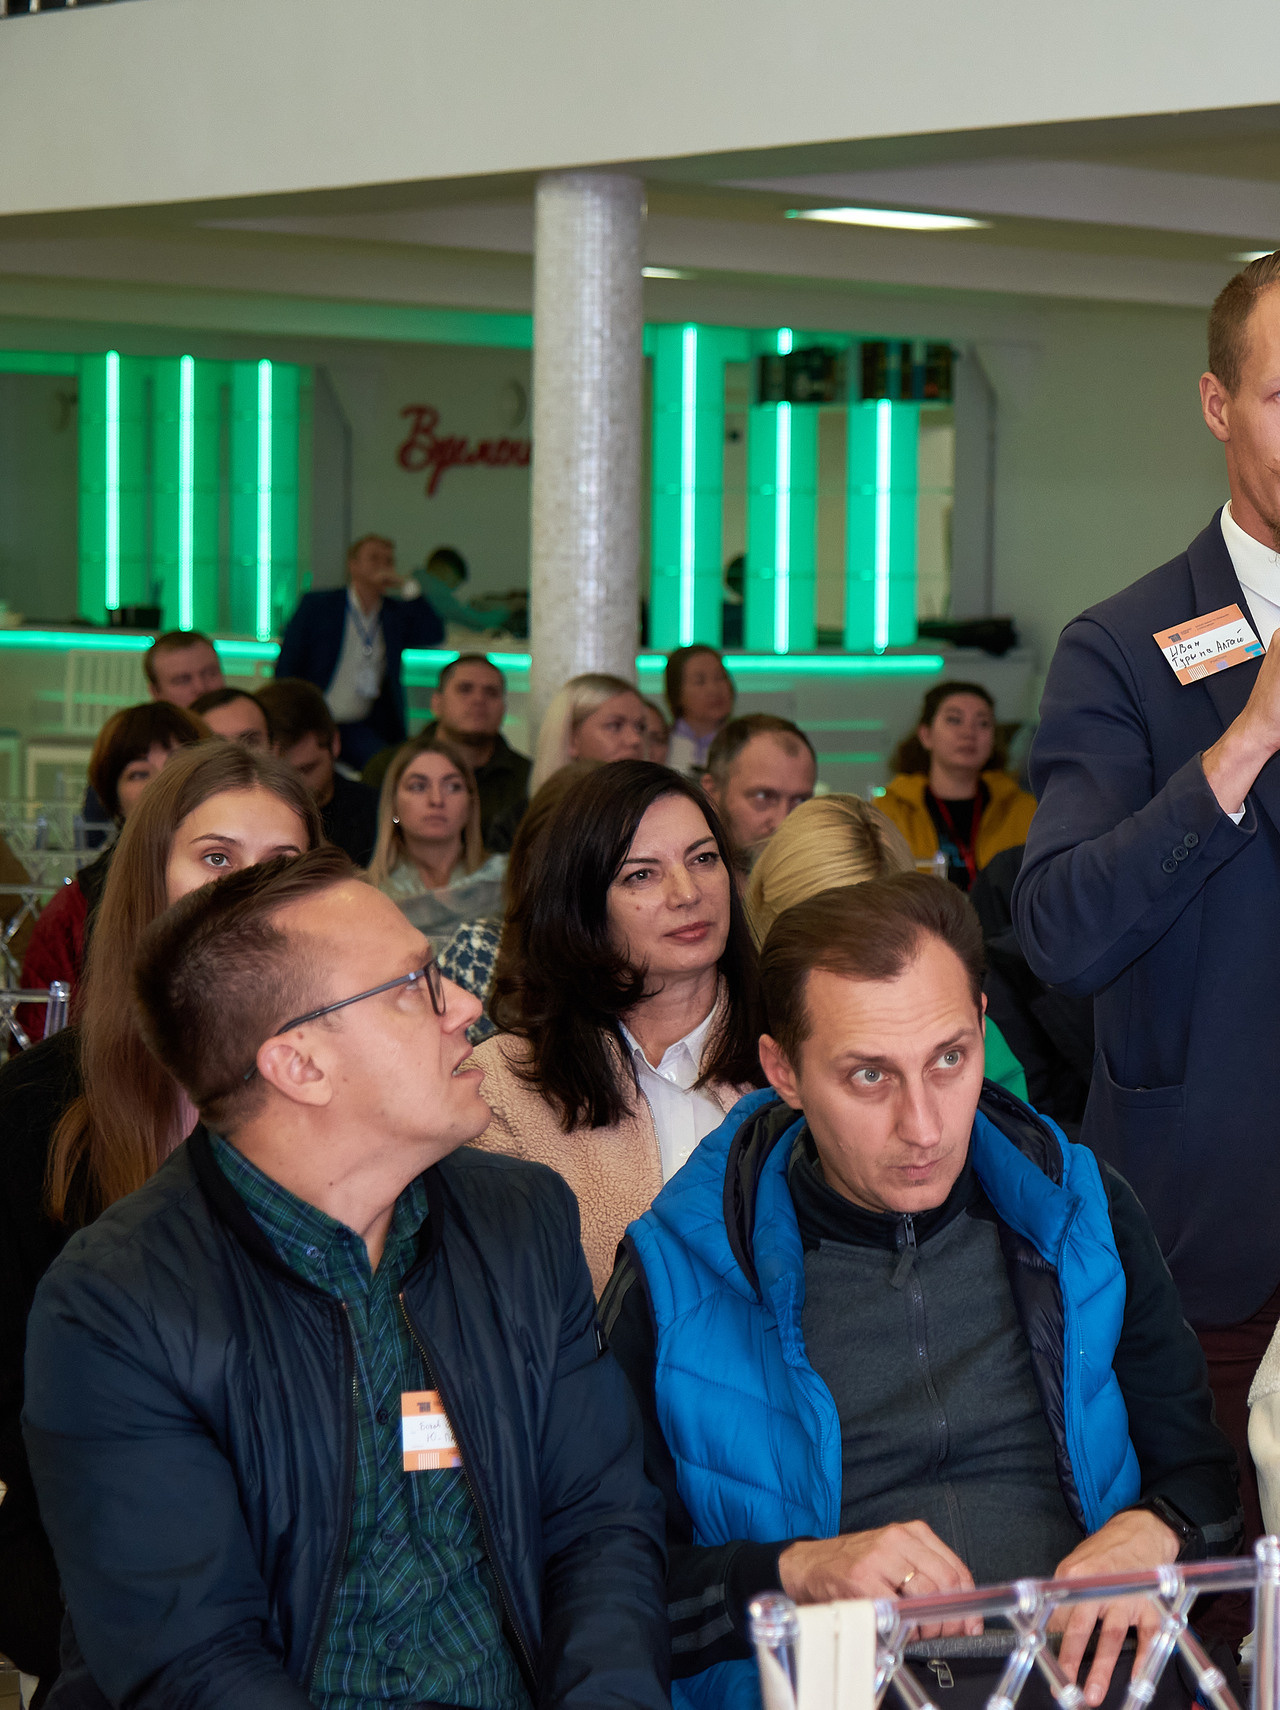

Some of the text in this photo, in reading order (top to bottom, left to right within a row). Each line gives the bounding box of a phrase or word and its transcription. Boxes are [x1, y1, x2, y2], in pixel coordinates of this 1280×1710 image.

[1169, 640, 1200, 658] Иван
[1171, 653, 1198, 669] Туры
[1199, 648, 1213, 658] на
[1216, 628, 1245, 653] Алтай
